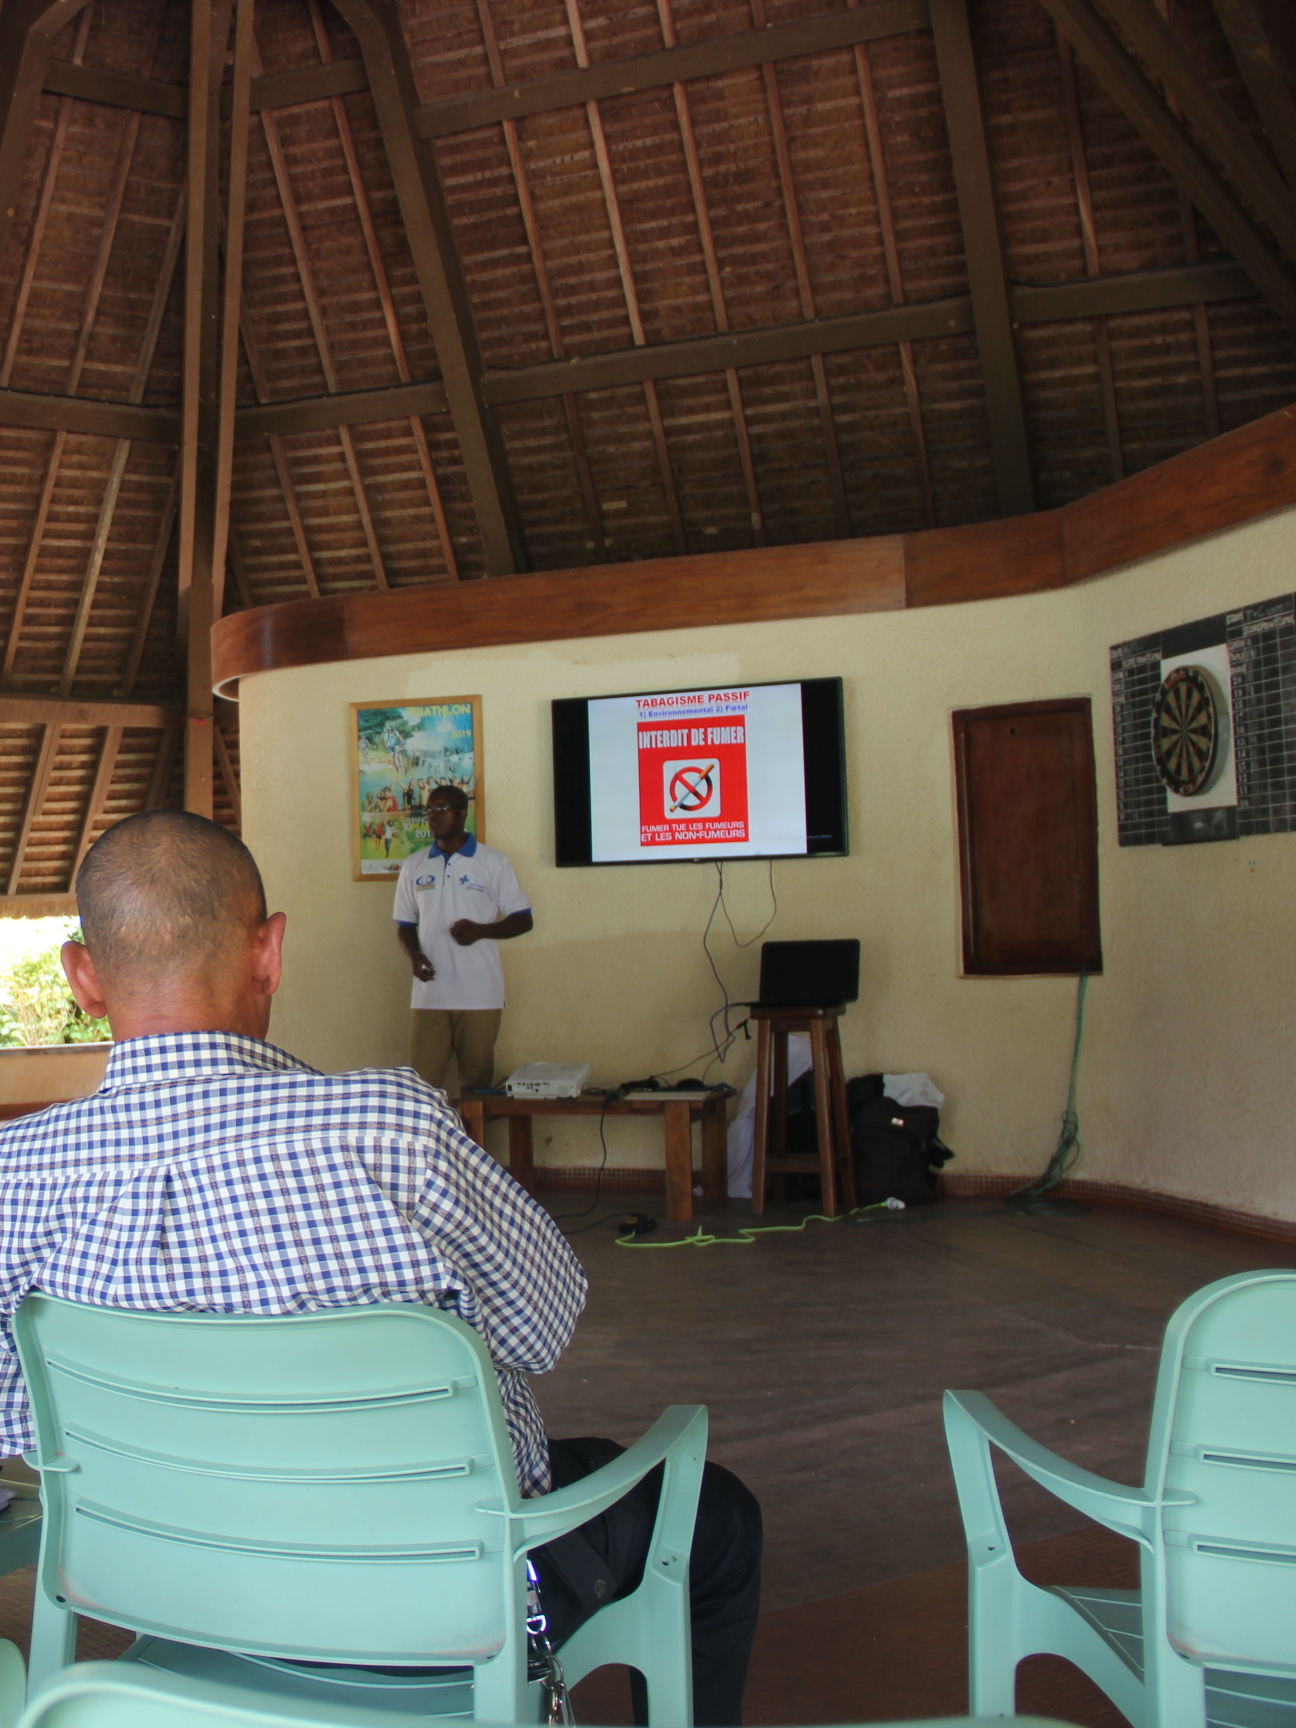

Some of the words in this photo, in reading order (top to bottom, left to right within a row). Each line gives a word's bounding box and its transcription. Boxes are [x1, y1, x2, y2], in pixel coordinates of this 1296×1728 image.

[636, 695, 704, 708] TABAGISME
[709, 691, 750, 702] PASSIF
[408, 705, 470, 717] TRIATHLON
[649, 707, 713, 717] Environnemental
[452, 730, 472, 738] 2019
[639, 730, 688, 748] INTERDIT
[692, 728, 705, 745] DE
[708, 727, 744, 745] FUMER
[415, 830, 431, 838] 201
[641, 833, 652, 842] ET
[656, 833, 672, 841] LES
[676, 830, 745, 840] NON-FUMEURS
